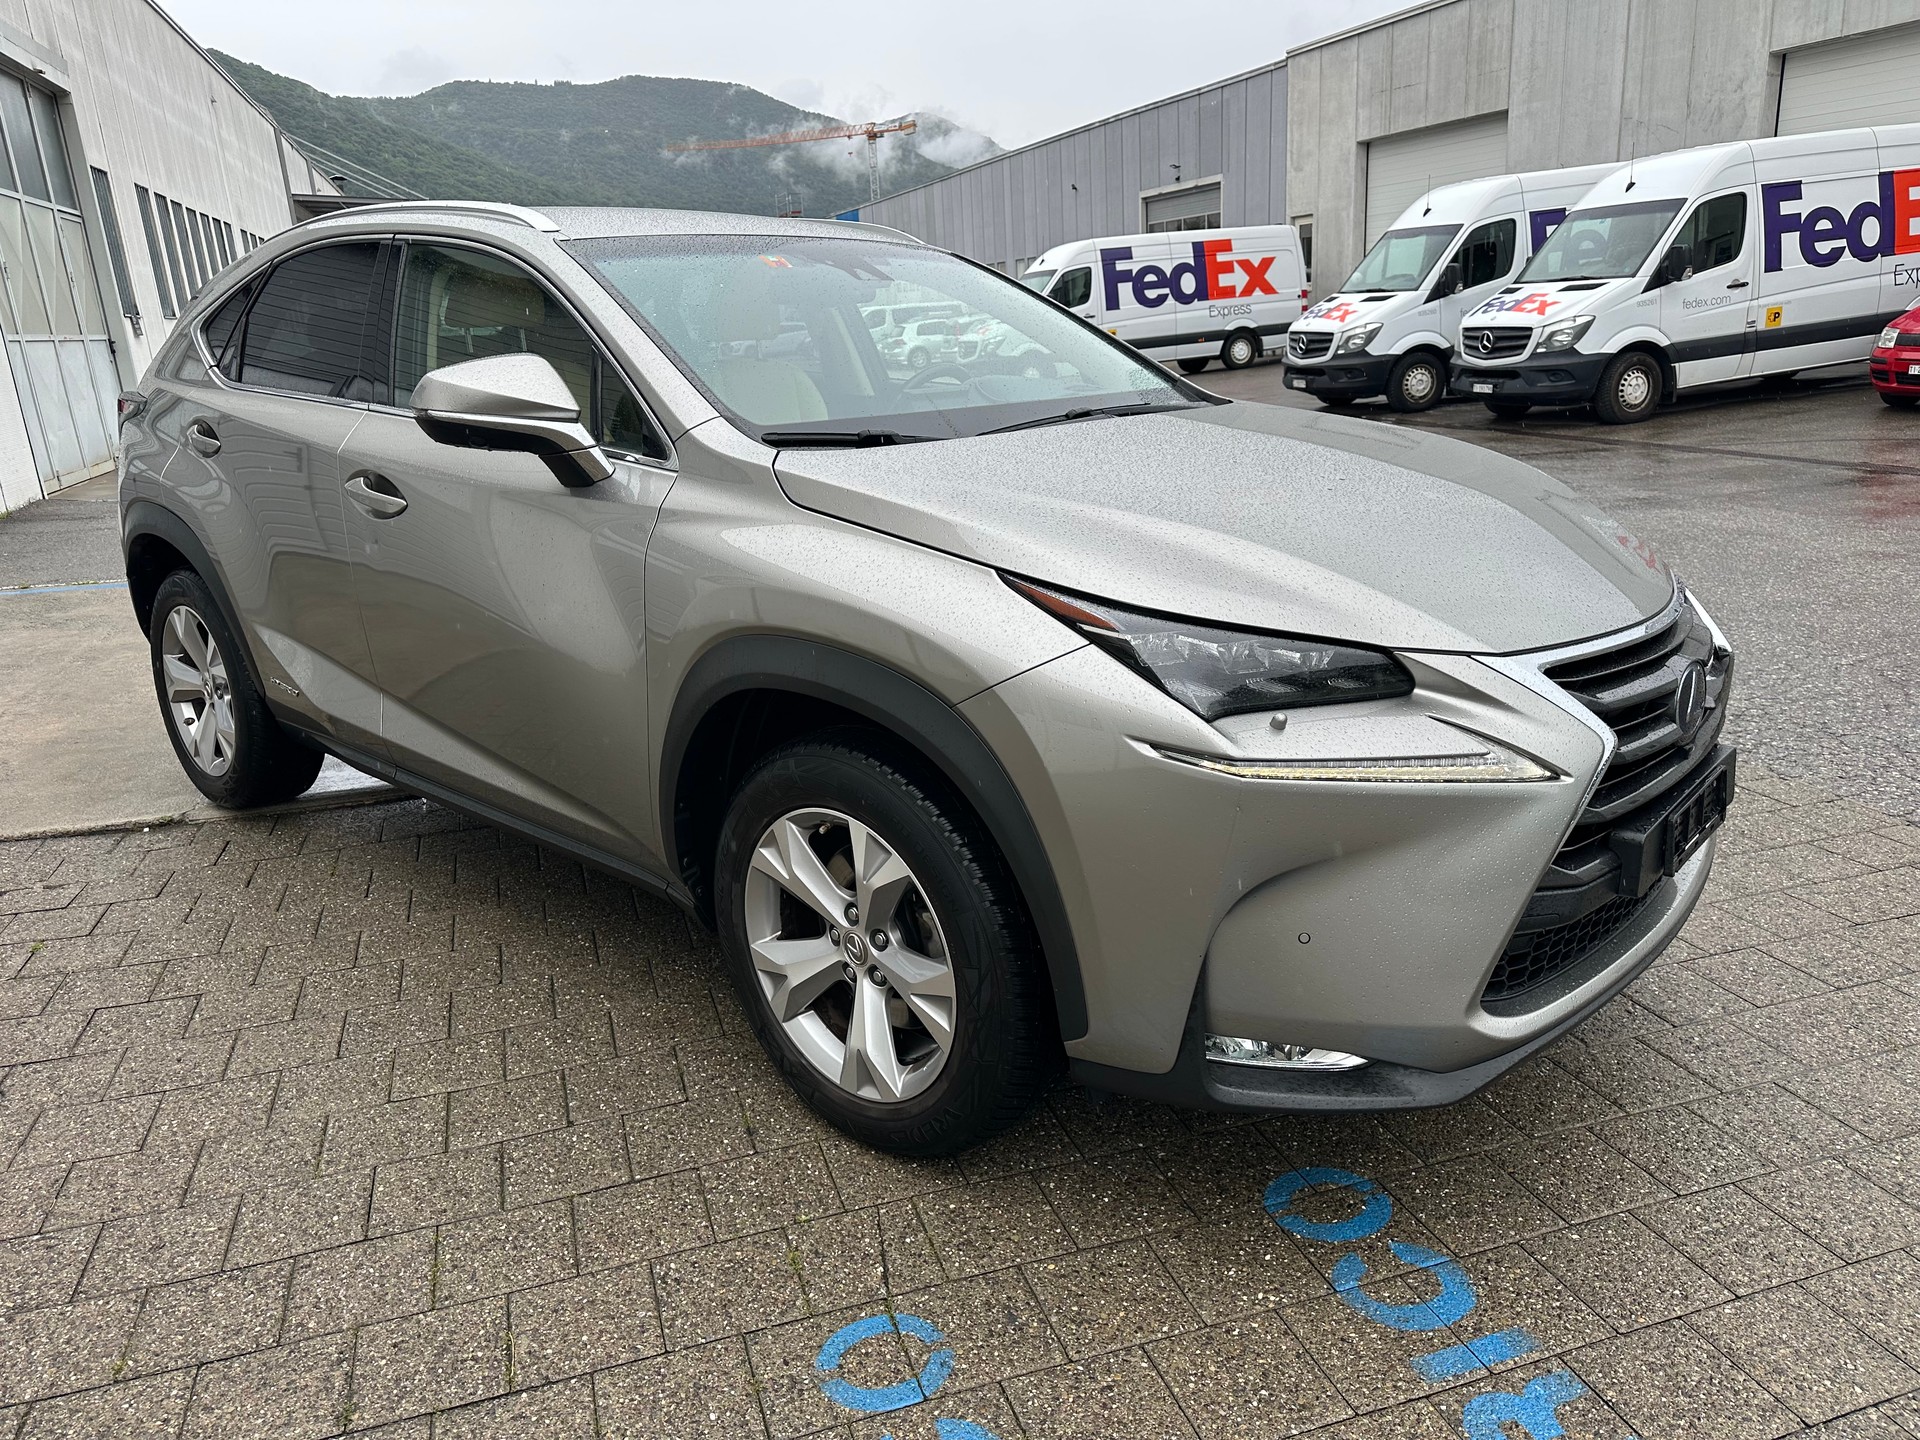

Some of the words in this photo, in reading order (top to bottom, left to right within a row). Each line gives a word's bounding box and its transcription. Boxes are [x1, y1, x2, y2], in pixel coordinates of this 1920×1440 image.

[1100, 239, 1277, 311] FedEx
[1208, 303, 1252, 319] Express
[1467, 293, 1562, 316] FedEx
[1682, 294, 1732, 310] fedex.com
